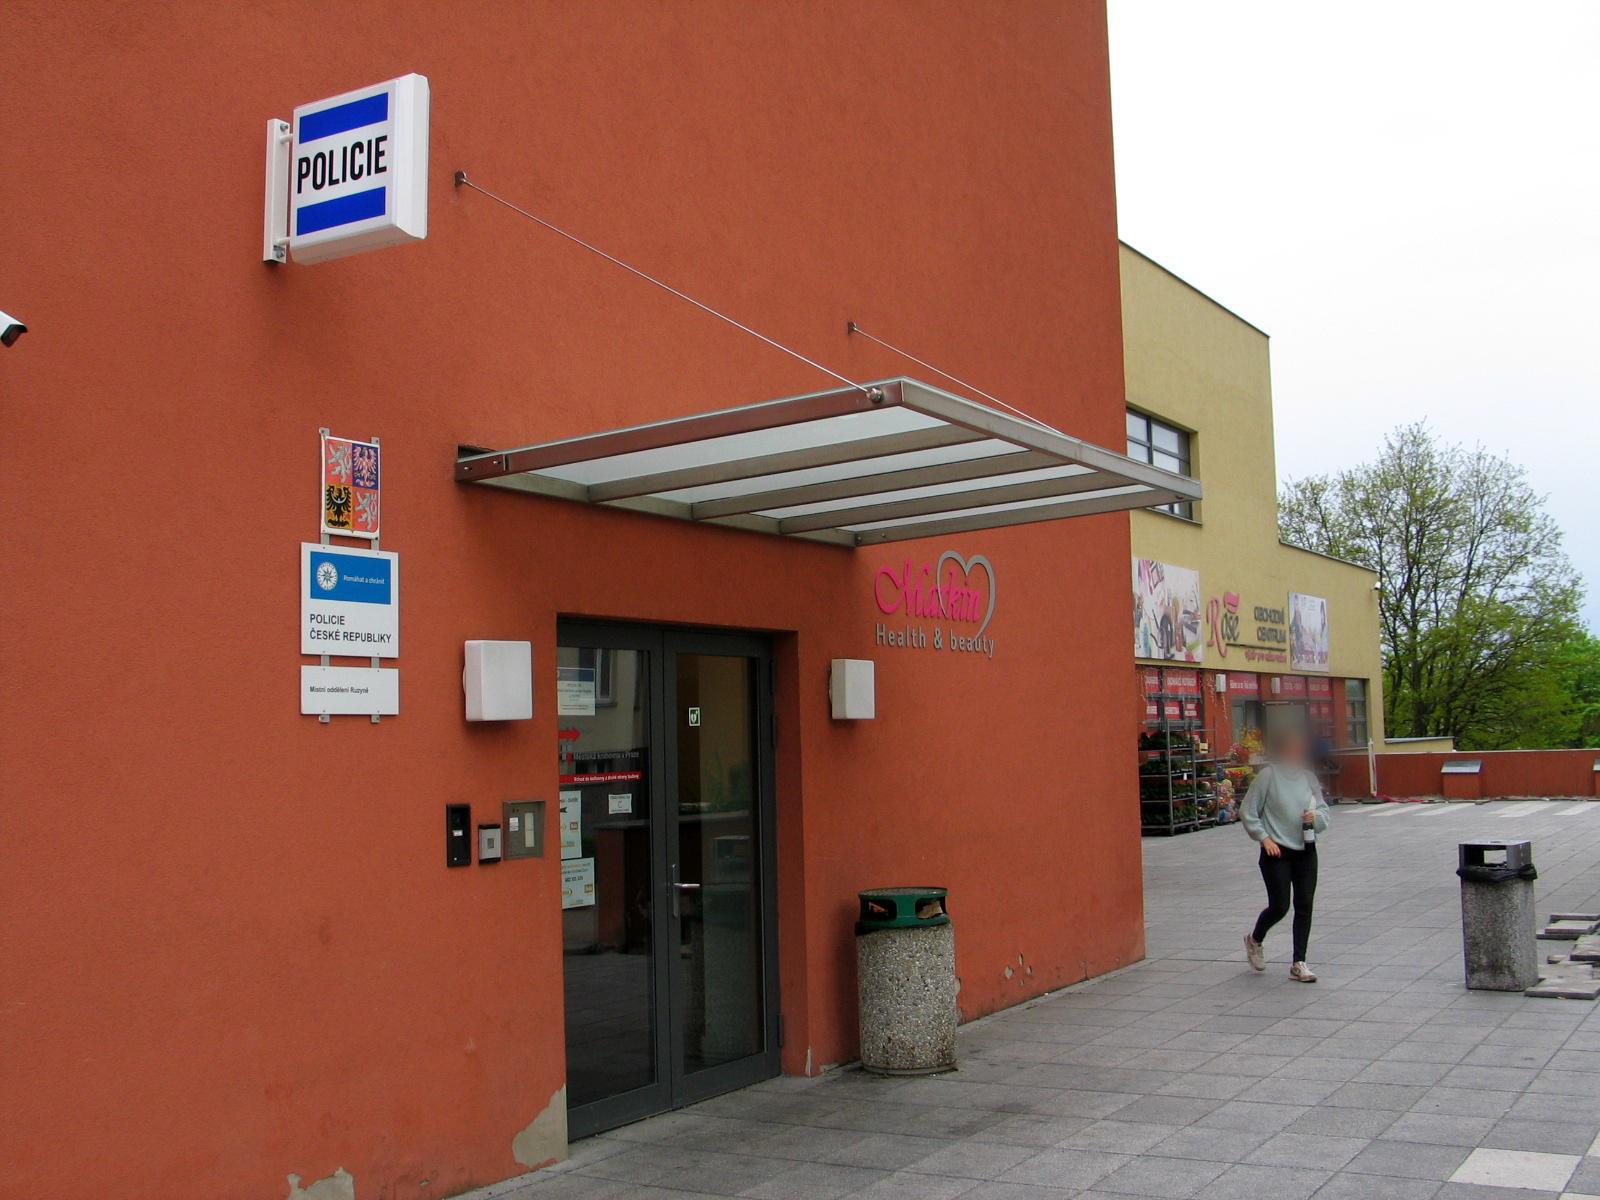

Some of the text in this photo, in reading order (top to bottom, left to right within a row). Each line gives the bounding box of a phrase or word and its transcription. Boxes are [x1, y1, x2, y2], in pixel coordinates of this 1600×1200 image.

[297, 135, 387, 194] POLICIE
[309, 613, 345, 626] POLICIE
[309, 627, 392, 644] ČESKÉ REPUBLIKY
[876, 623, 994, 659] Health & beauty
[327, 686, 349, 694] oddělení
[350, 686, 369, 695] Ruzyně
